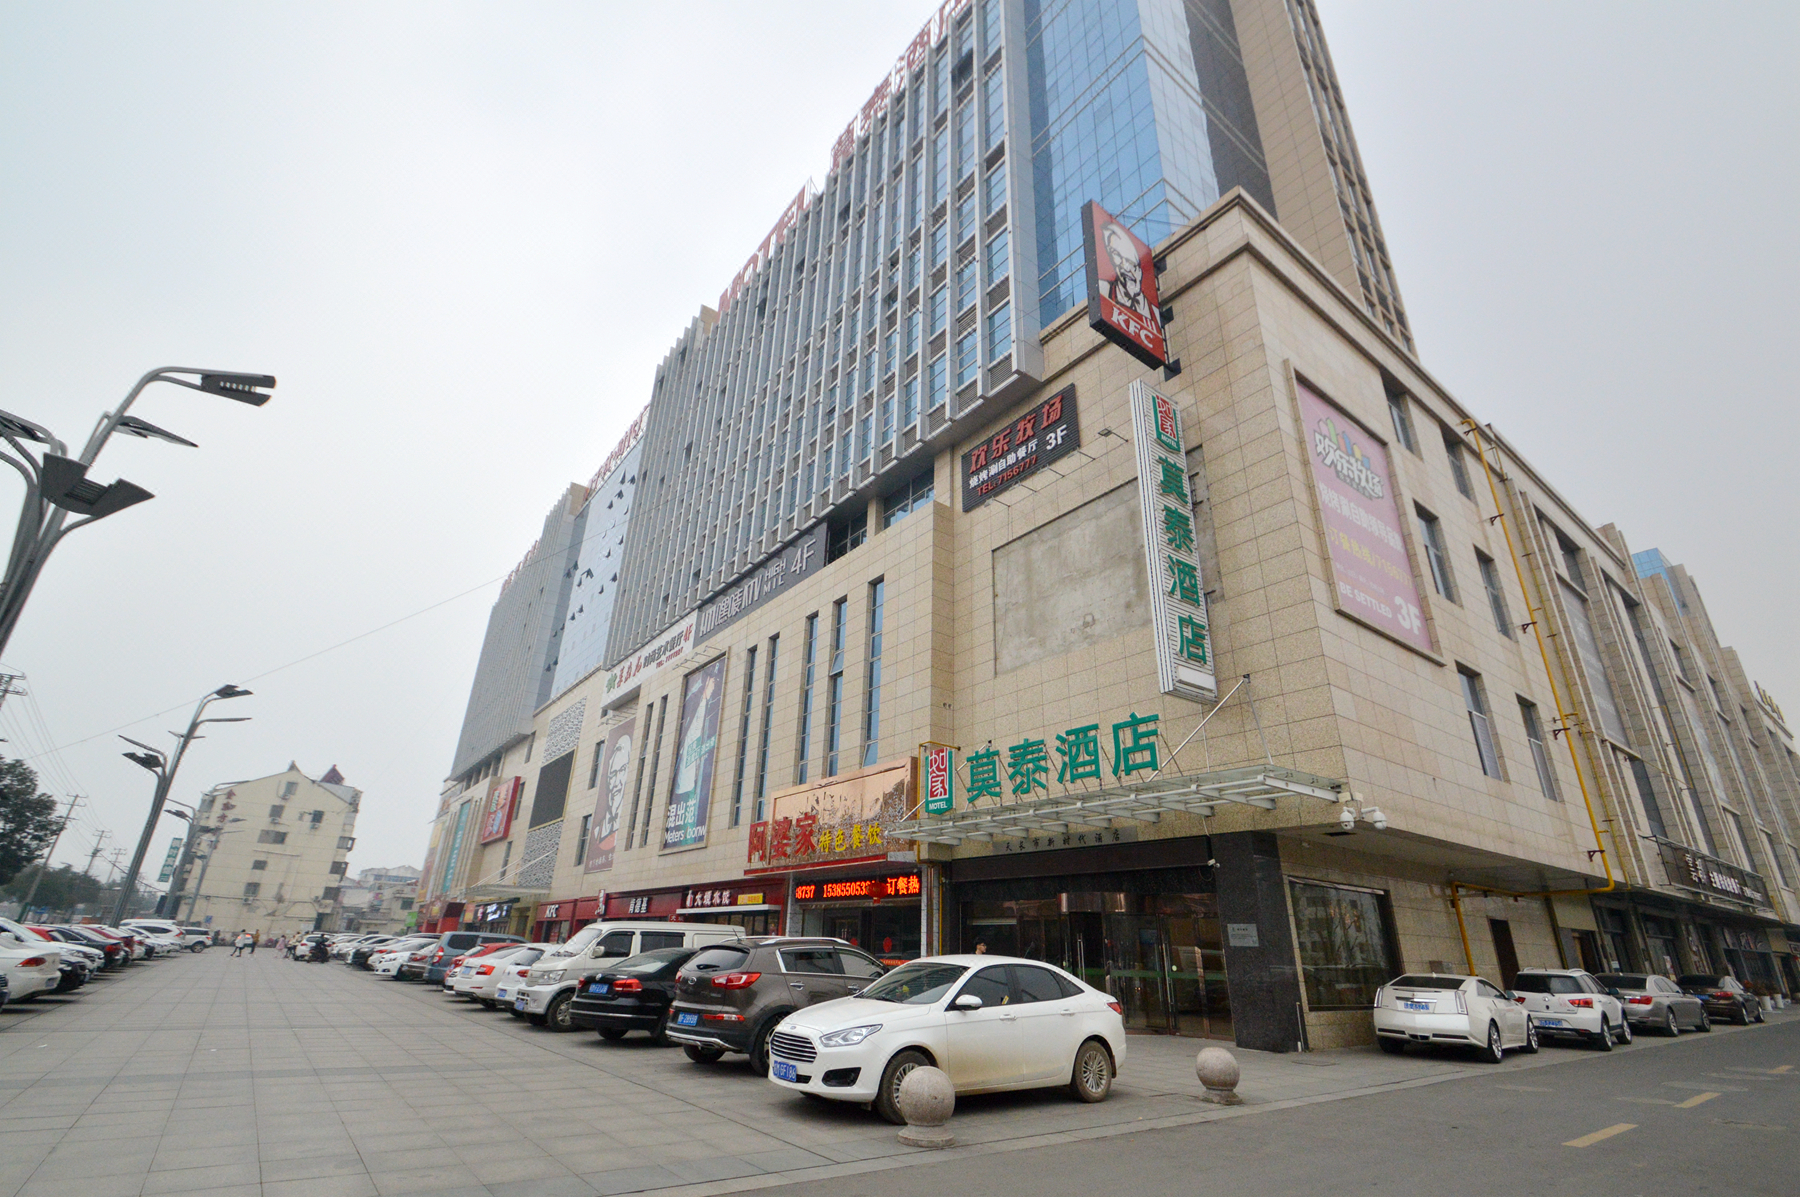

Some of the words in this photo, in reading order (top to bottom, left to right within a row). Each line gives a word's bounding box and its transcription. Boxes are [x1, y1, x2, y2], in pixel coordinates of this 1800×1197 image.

[1111, 306, 1153, 348] KFC
[969, 395, 1063, 474] 欢乐牧场
[1045, 424, 1067, 450] 3F
[1161, 433, 1178, 449] MOTEL
[1313, 430, 1383, 498] 欢乐牧场
[764, 558, 787, 581] HIGH
[791, 539, 817, 574] 4F
[1157, 455, 1208, 666] 莫泰酒店
[1340, 581, 1353, 598] BE
[1355, 588, 1392, 618] SETTLED
[1394, 595, 1422, 635] 3F
[966, 712, 1160, 803] 莫泰酒店
[929, 802, 947, 810] MOTEL
[748, 812, 817, 863] 阿婆家
[819, 822, 882, 852] 特色餐饮
[887, 876, 919, 896] 订餐热
[545, 905, 559, 918] KFC
